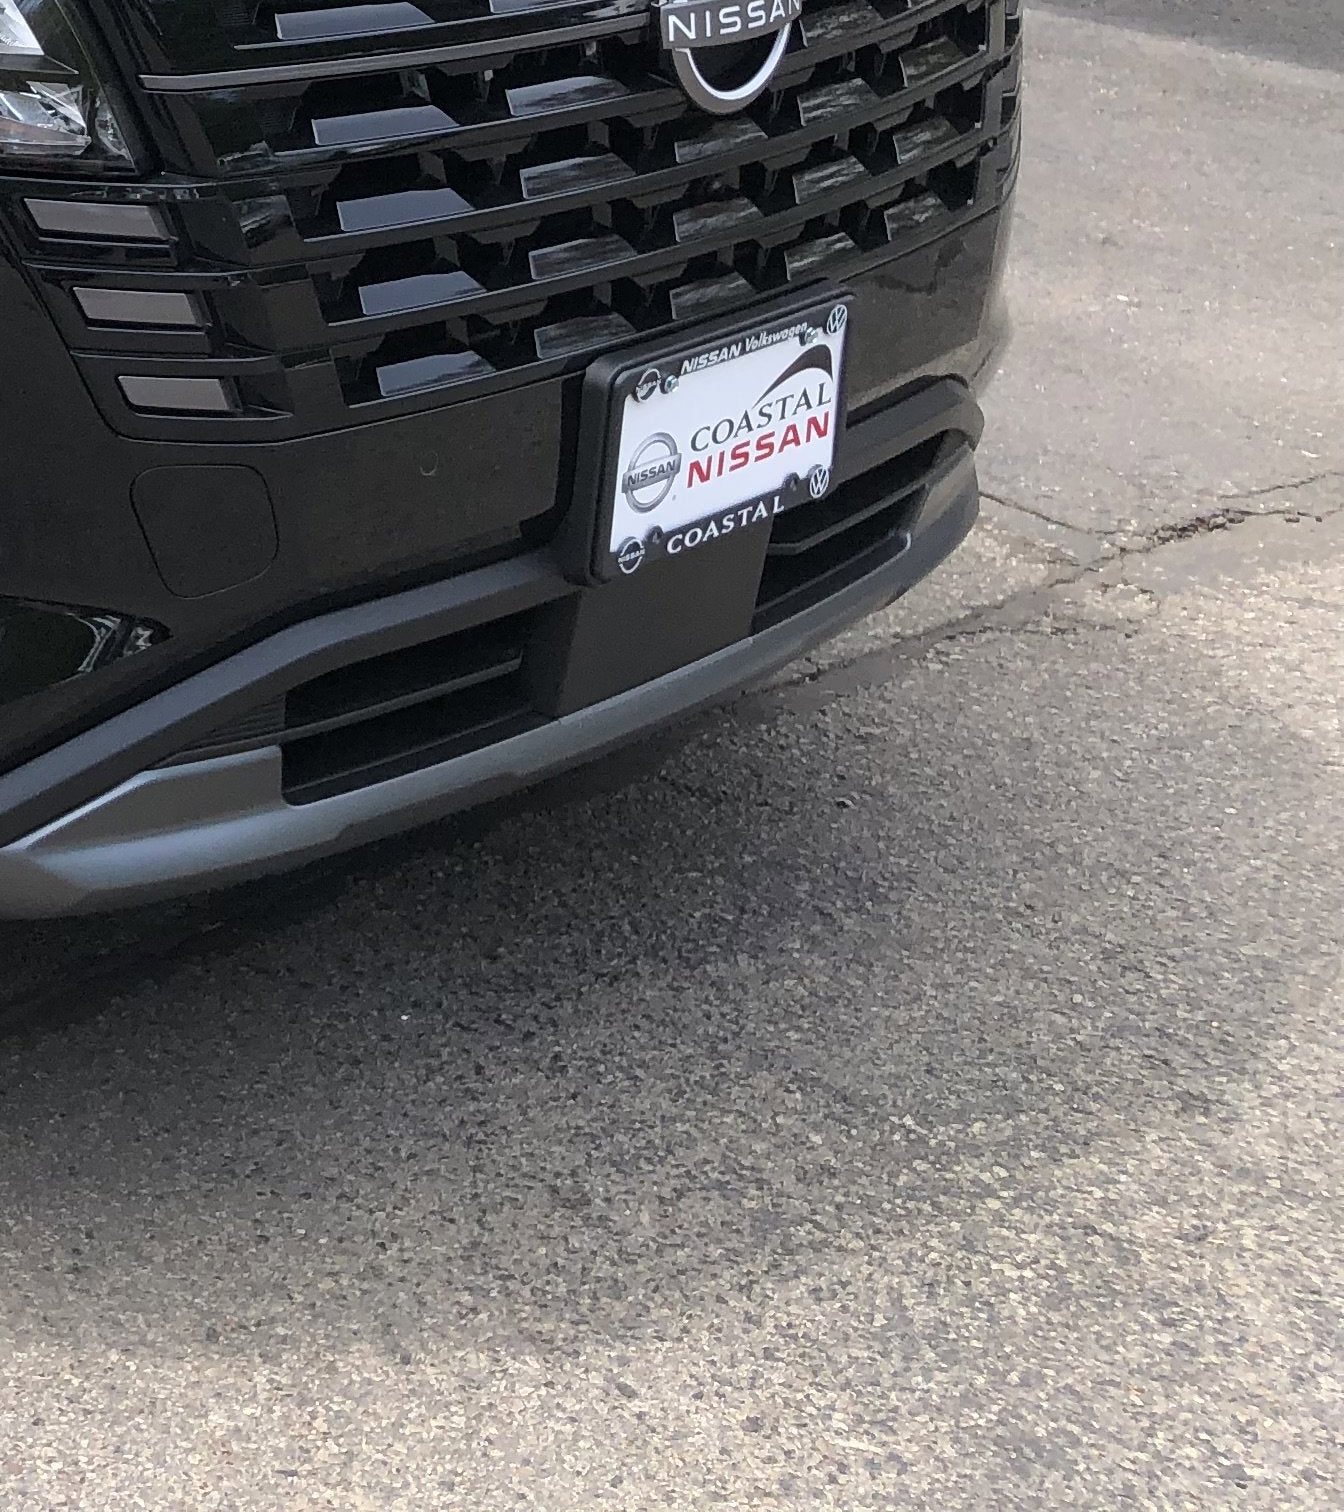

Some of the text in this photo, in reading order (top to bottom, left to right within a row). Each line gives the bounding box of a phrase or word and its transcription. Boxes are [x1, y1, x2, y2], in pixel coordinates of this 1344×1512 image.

[680, 341, 743, 376] NISSAN
[690, 381, 833, 453] COASTAL
[627, 459, 677, 487] NISSAN
[686, 410, 830, 489] NISSAN
[666, 494, 786, 555] COASTAL
